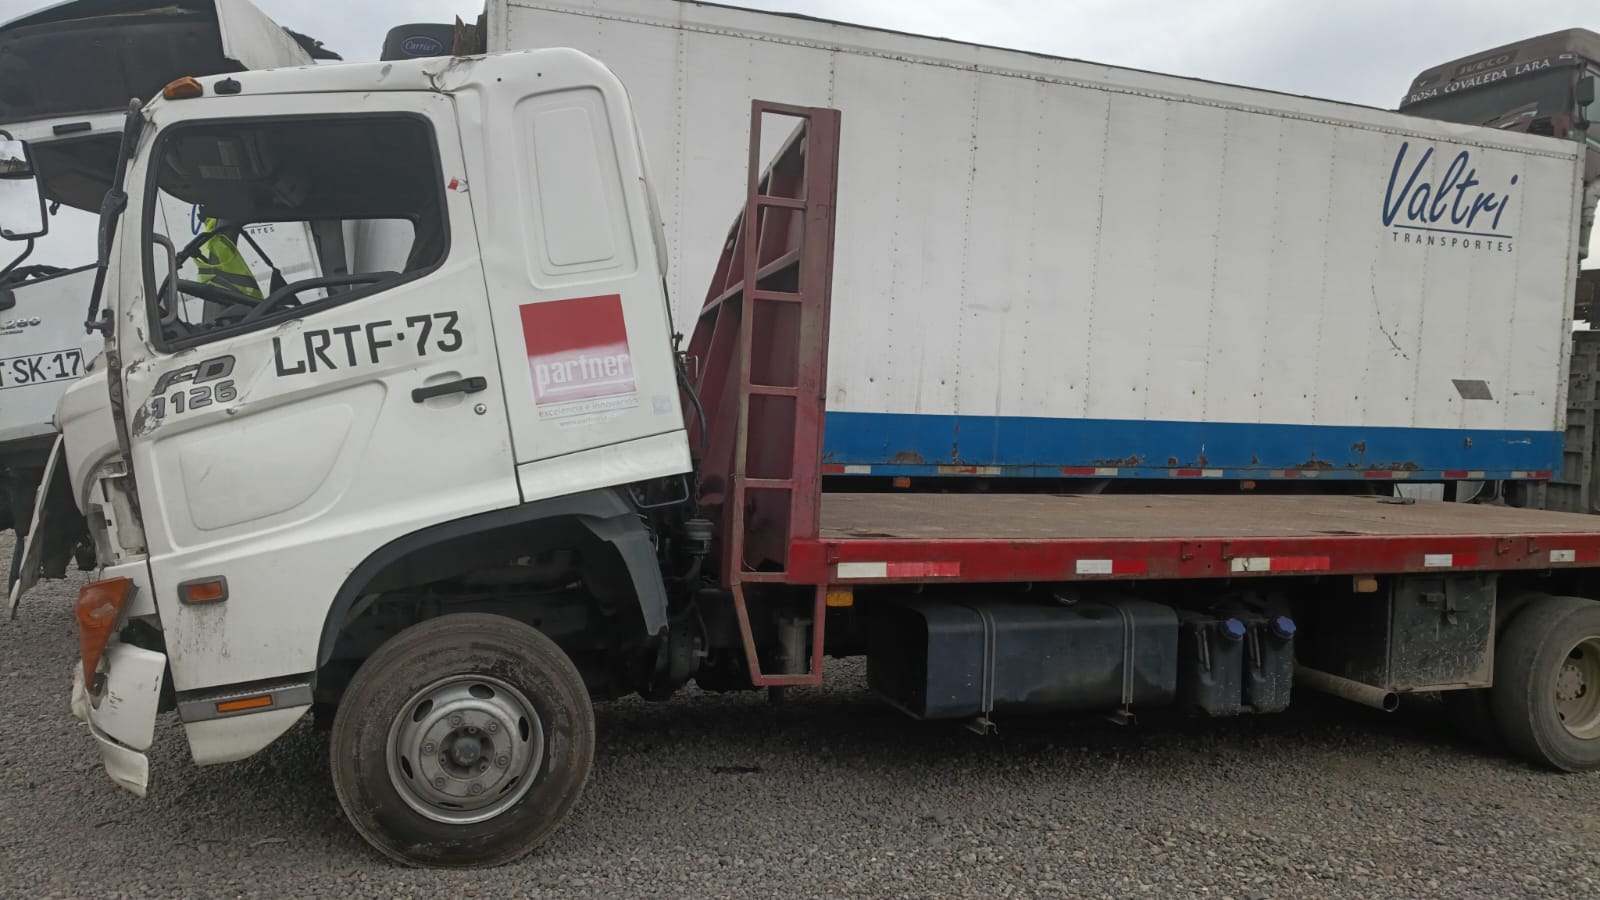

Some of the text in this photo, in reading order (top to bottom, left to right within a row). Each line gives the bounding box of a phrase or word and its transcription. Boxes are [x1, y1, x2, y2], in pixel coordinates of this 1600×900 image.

[1410, 58, 1550, 103] ROSA COVALEDA LARA
[1459, 55, 1510, 74] IVECO
[1382, 141, 1519, 230] Valtri
[1392, 231, 1513, 253] TRANSPORTES
[0, 316, 41, 330] 280
[151, 354, 236, 397] FD
[534, 353, 630, 398] partner
[151, 379, 237, 419] 1126
